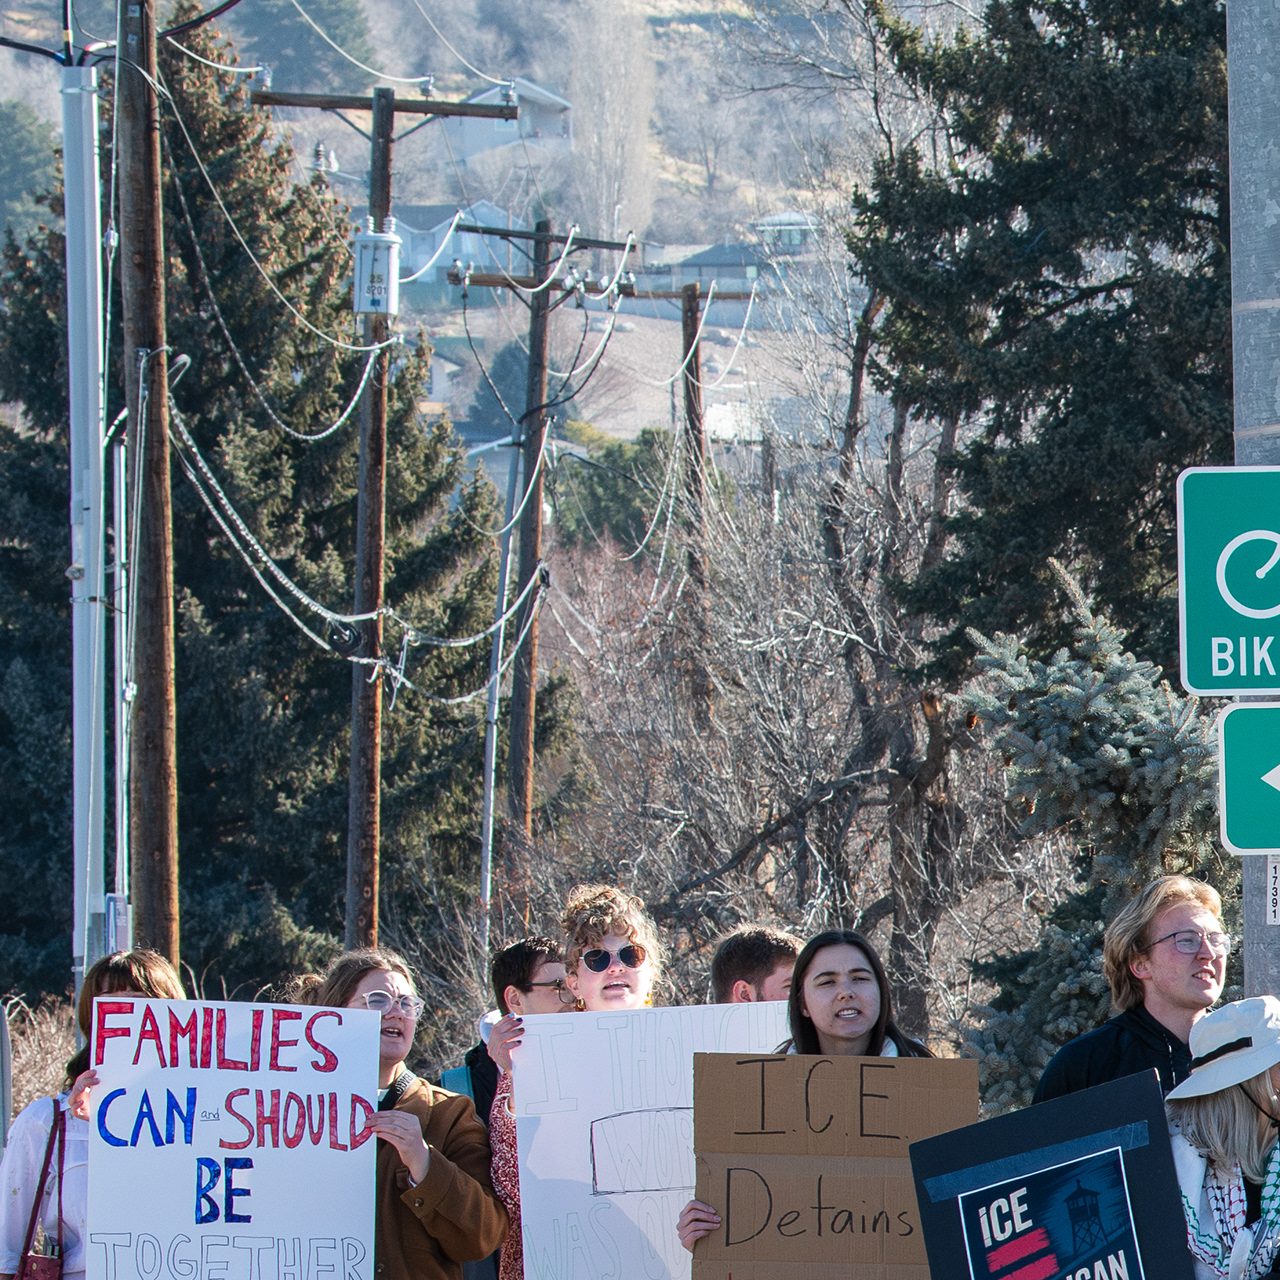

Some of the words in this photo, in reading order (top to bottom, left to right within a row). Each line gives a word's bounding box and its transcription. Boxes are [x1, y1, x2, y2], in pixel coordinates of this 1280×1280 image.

[95, 1002, 343, 1073] FAMILIES
[522, 1022, 578, 1115] I
[97, 1087, 197, 1147] CAN
[200, 1109, 220, 1121] and
[219, 1087, 377, 1152] SHOULD
[196, 1157, 254, 1225] BE
[725, 1167, 914, 1247] Detains
[978, 1187, 1034, 1248] ICE
